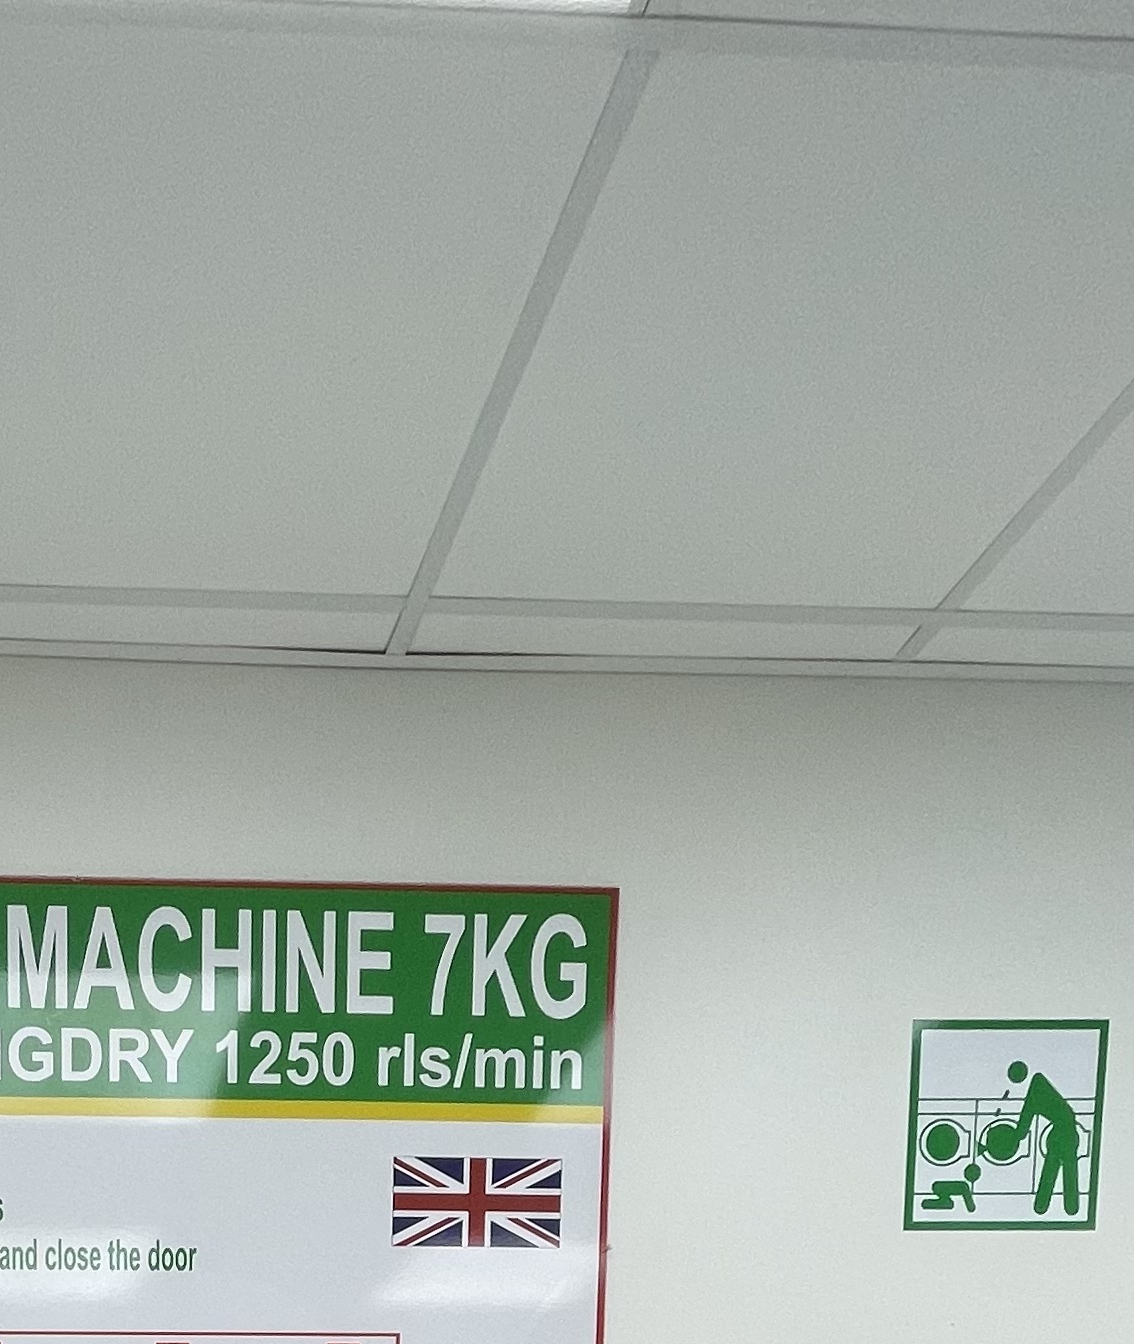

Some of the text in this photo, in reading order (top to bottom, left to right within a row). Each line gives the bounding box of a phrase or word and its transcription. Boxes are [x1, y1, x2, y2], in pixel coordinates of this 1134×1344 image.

[7, 904, 394, 1016] MACHINE
[425, 913, 587, 1020] 7KG
[217, 1030, 354, 1086] 1250
[377, 1033, 583, 1090] rls/min
[0, 1238, 36, 1271] and
[46, 1238, 100, 1271] close
[108, 1239, 140, 1271] the
[148, 1238, 196, 1271] door
